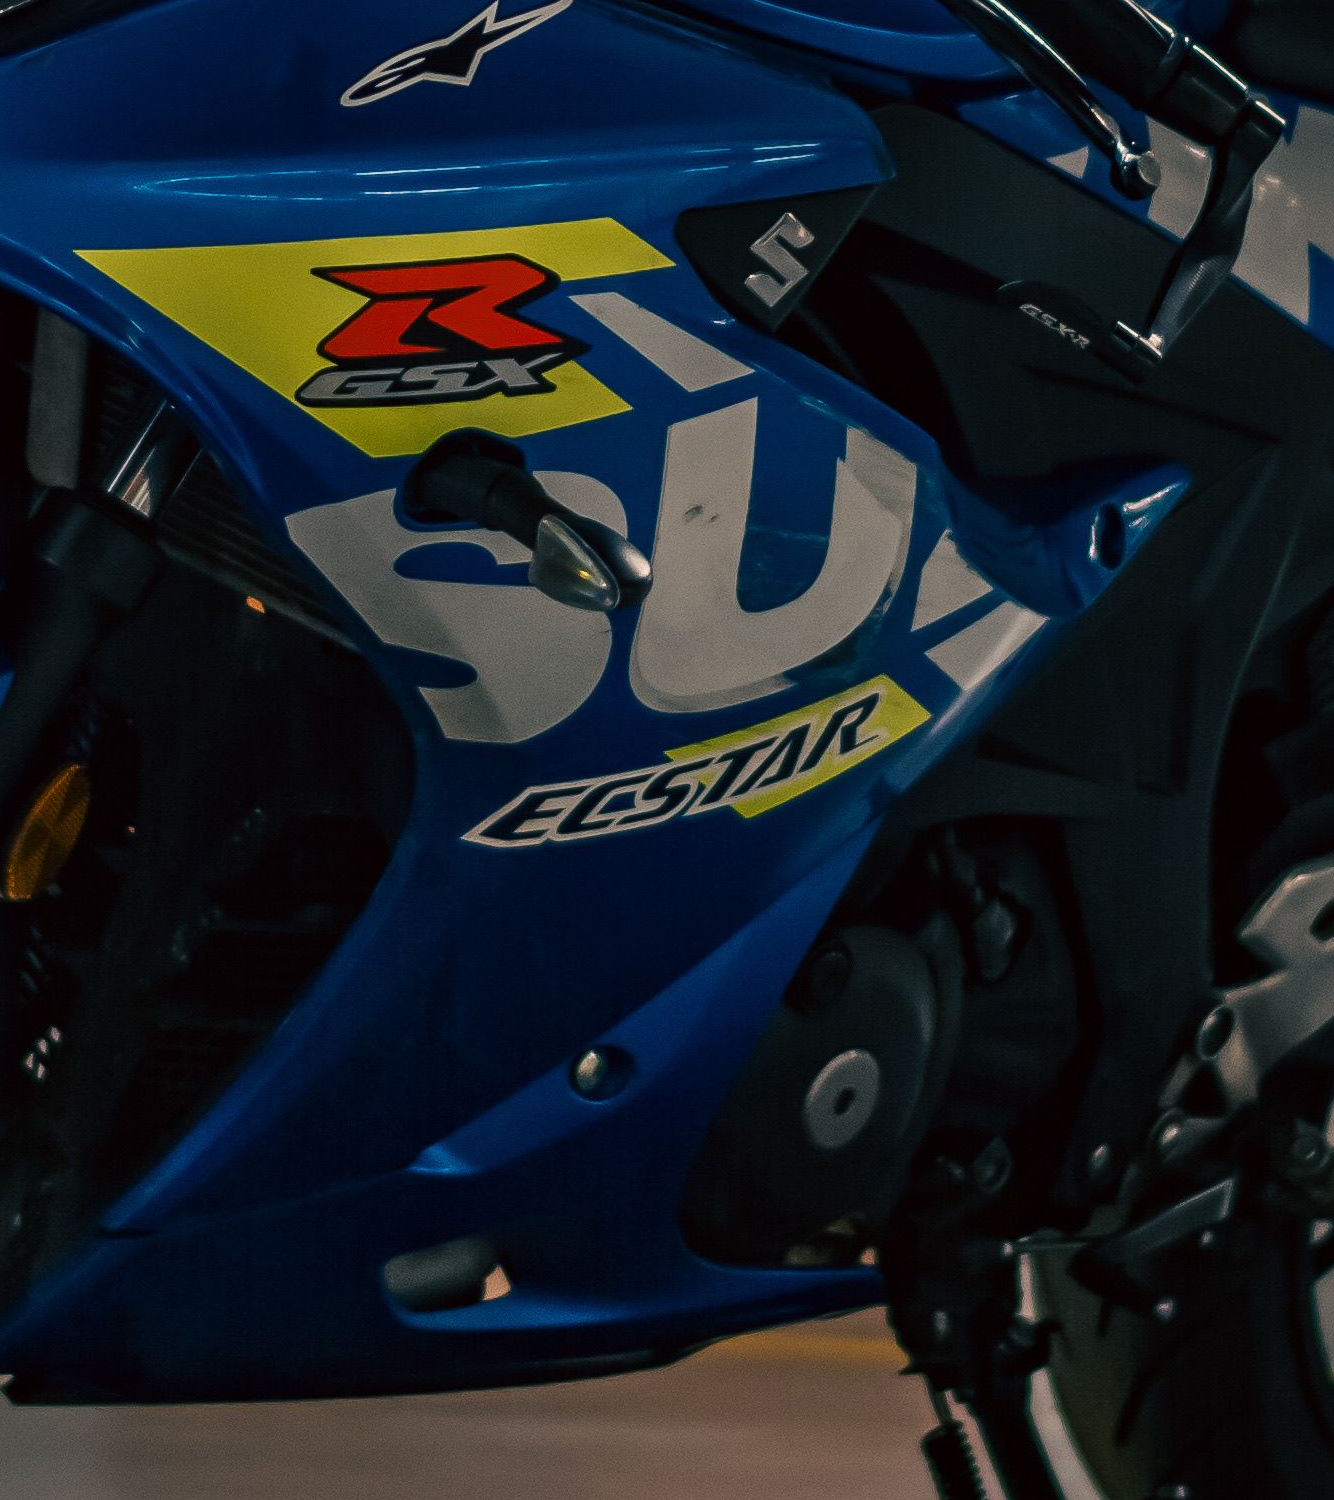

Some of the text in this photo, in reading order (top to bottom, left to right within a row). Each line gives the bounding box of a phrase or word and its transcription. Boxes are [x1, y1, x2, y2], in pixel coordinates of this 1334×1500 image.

[315, 254, 582, 363] R
[297, 350, 567, 404] GSX
[283, 396, 1051, 745] SU
[470, 688, 883, 844] ECSTAR
